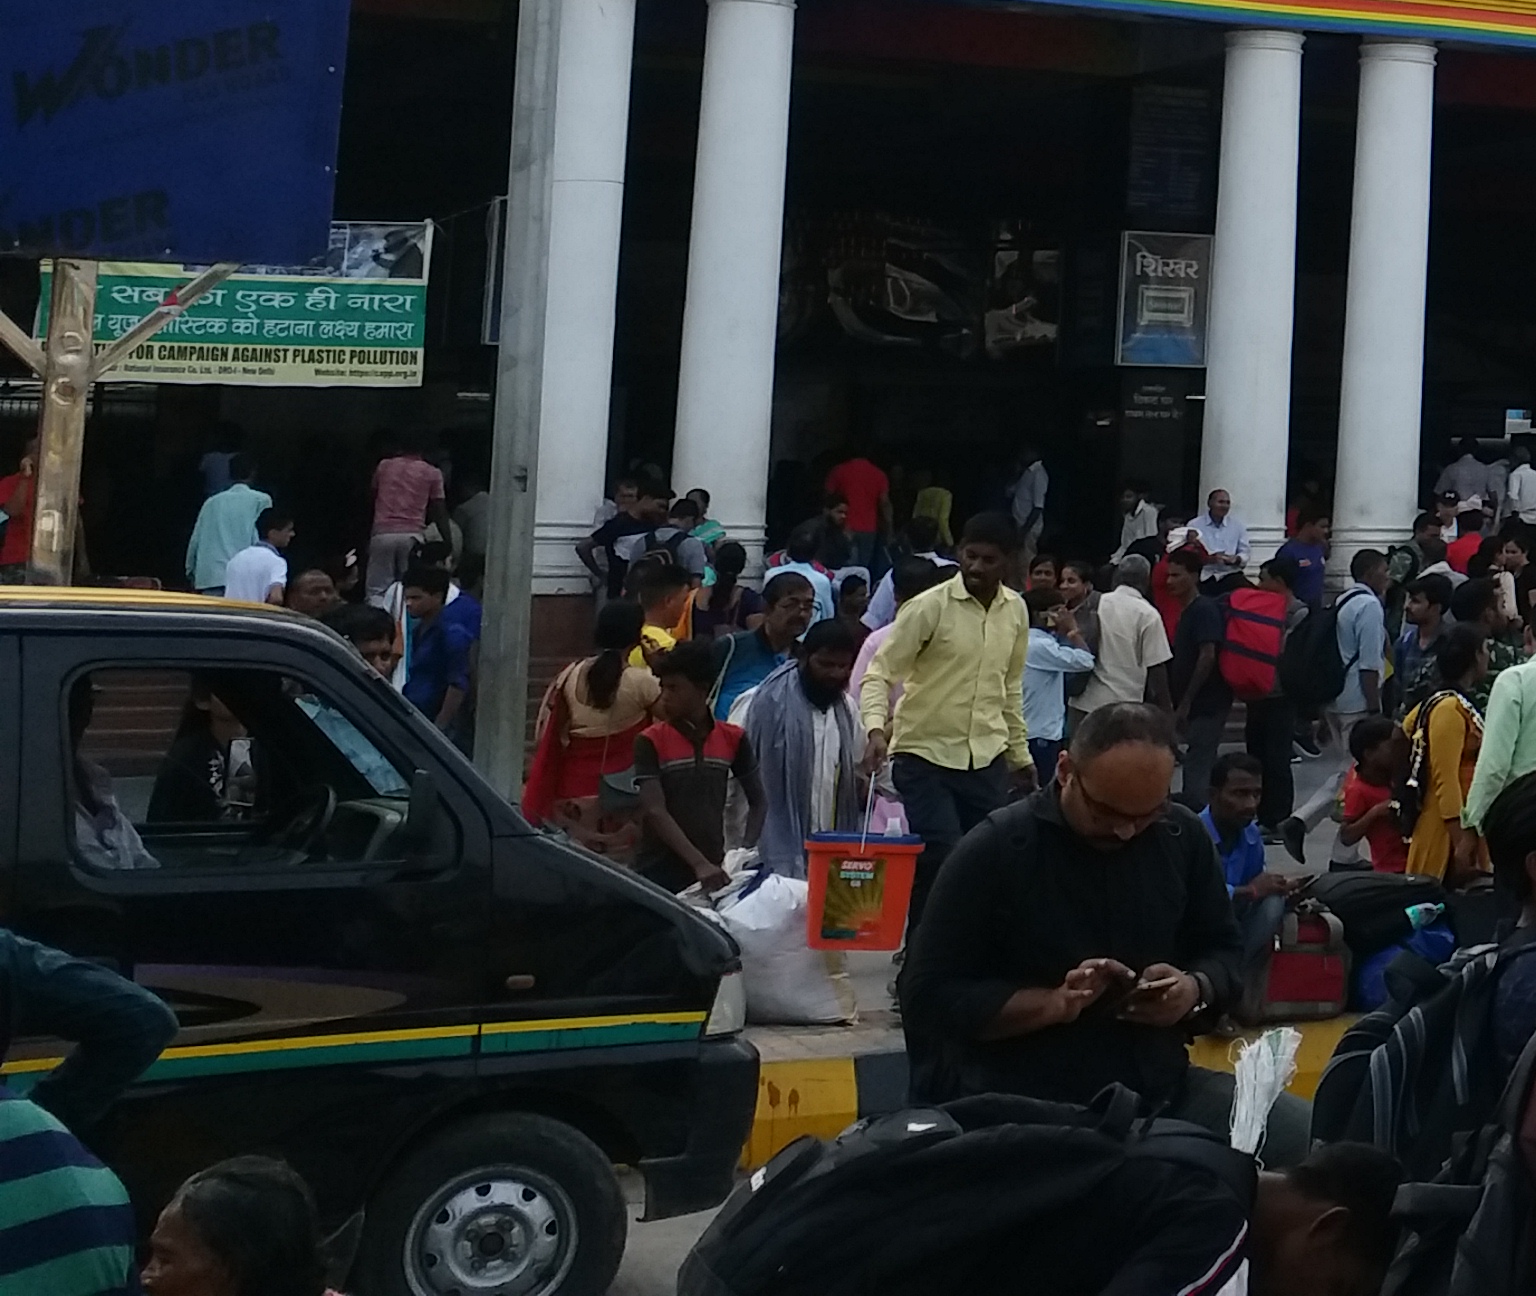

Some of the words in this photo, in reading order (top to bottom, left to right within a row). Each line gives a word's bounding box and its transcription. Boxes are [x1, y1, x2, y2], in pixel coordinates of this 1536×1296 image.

[12, 20, 282, 128] WONDER
[1135, 251, 1199, 279] शिखर
[234, 290, 299, 312] एक
[304, 286, 341, 311] ही
[347, 293, 418, 313] नारा
[232, 312, 261, 336] को
[263, 319, 316, 338] हटाना
[364, 321, 415, 340] हमारा
[158, 345, 229, 362] CAMPAIGN
[232, 346, 289, 363] AGAINST
[292, 348, 346, 364] PLASTIC
[349, 349, 418, 366] POLLUTION
